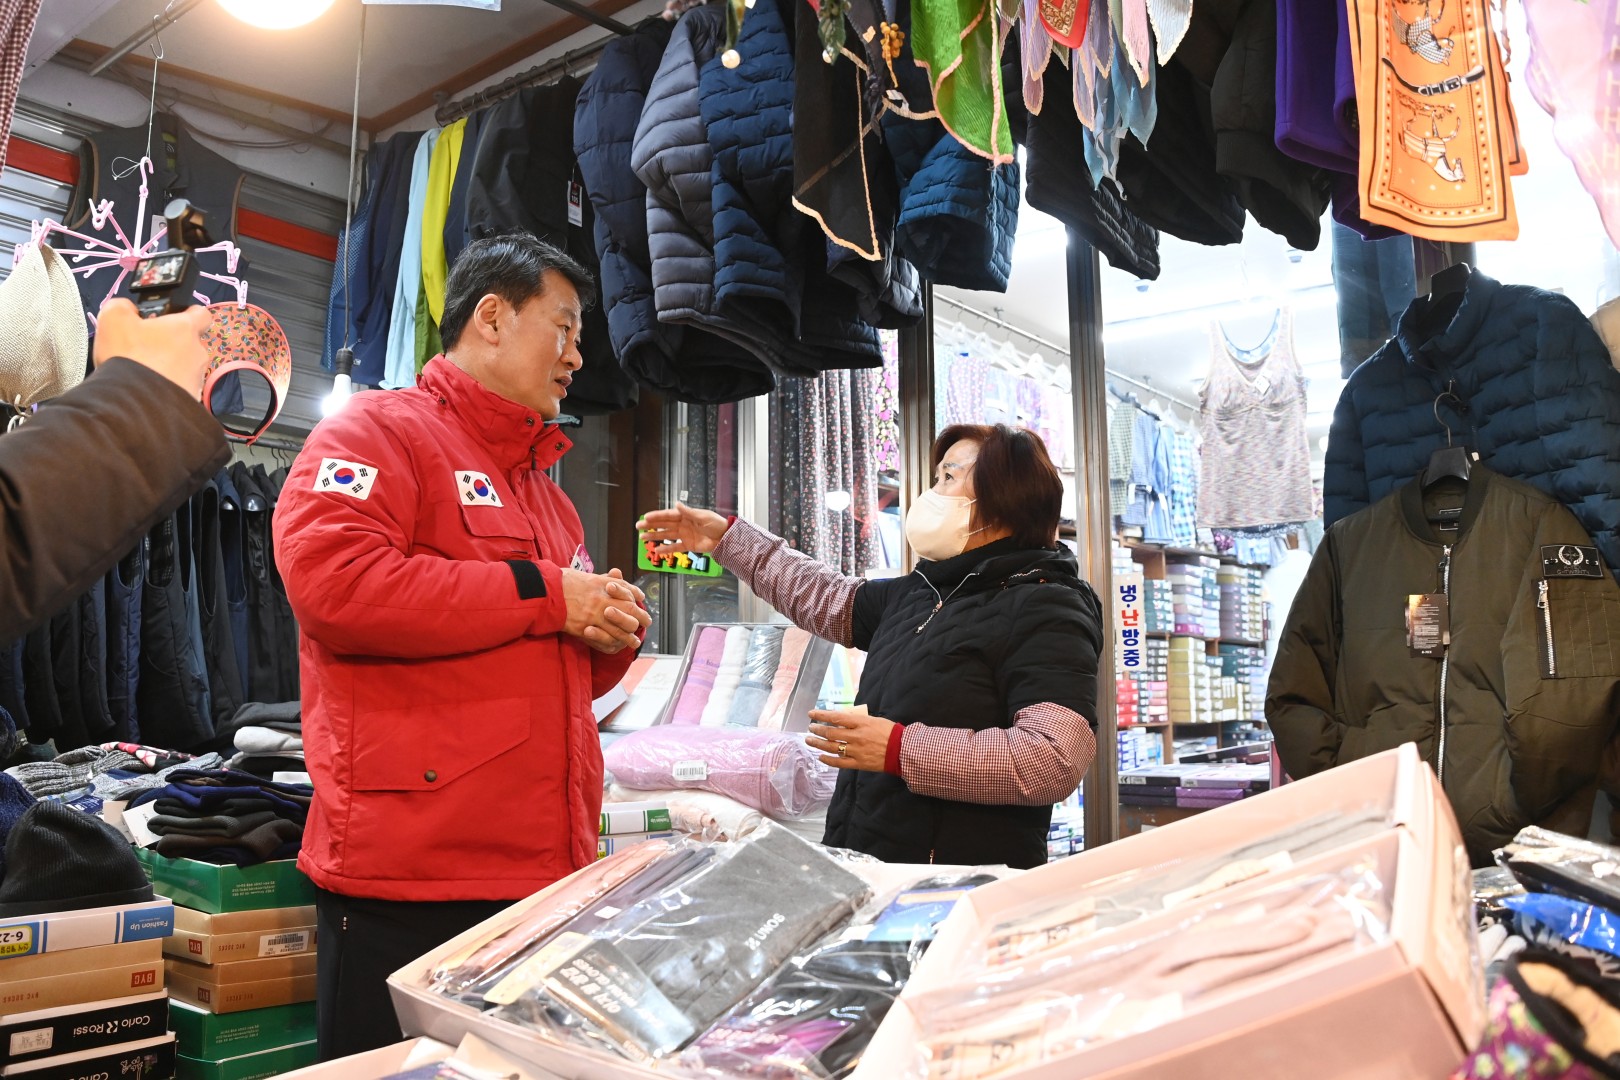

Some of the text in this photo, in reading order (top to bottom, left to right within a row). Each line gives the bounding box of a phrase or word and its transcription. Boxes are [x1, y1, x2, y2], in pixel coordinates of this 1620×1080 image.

[1120, 585, 1139, 667] 냉·난방중
[130, 920, 169, 931] Fashion Up
[754, 912, 785, 942] UNOS
[0, 931, 23, 944] 6-2
[189, 942, 201, 954] BYC
[134, 973, 153, 986] BYC
[198, 991, 209, 1002] BYC
[72, 1015, 151, 1038] Carlo Rossi
